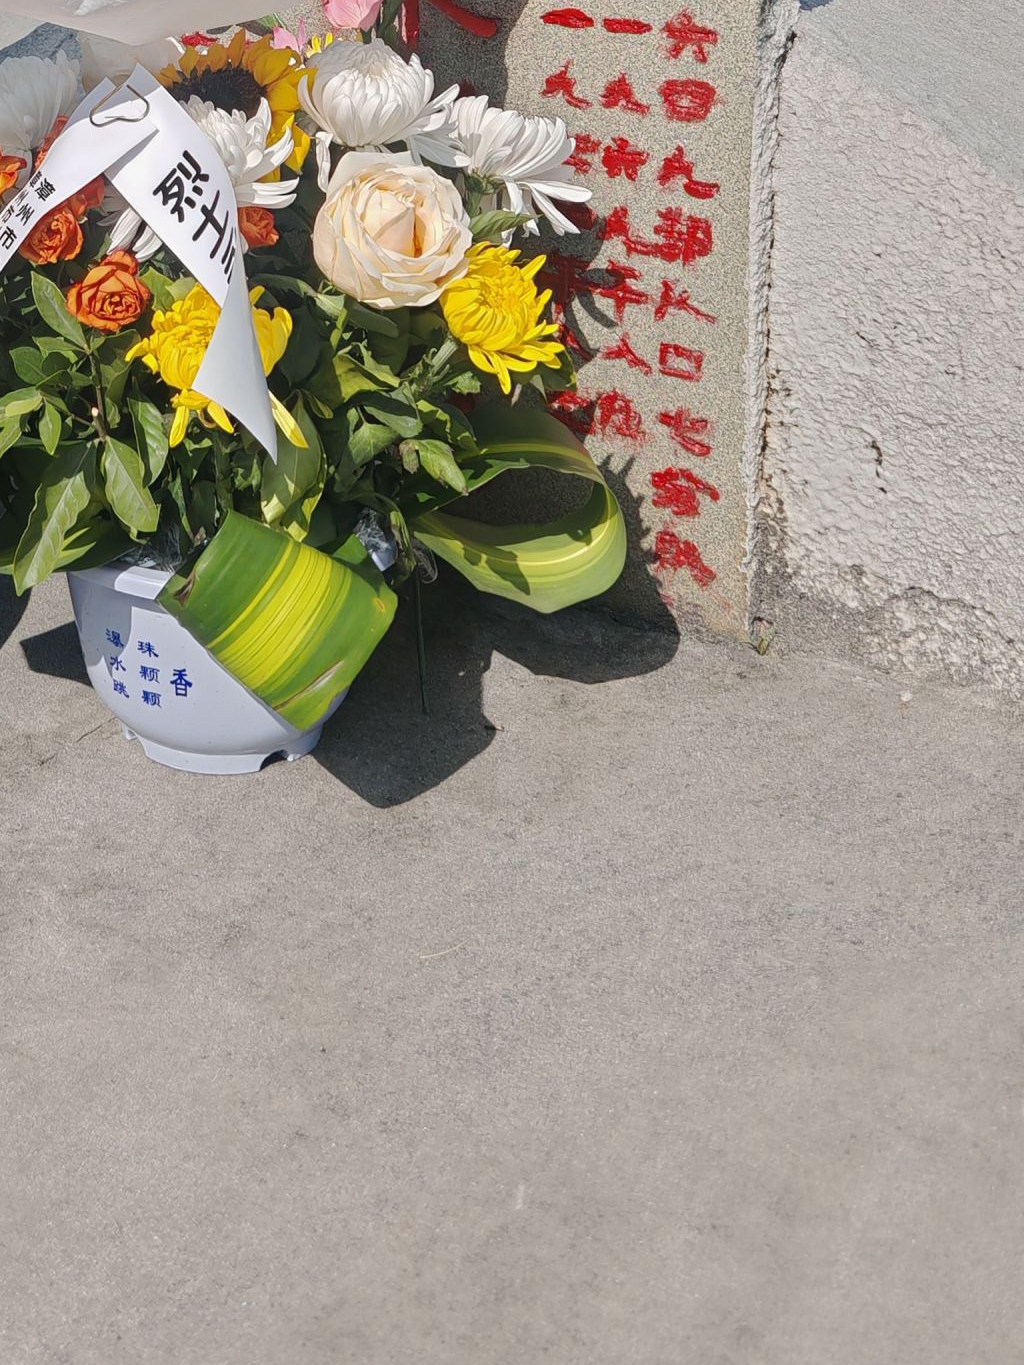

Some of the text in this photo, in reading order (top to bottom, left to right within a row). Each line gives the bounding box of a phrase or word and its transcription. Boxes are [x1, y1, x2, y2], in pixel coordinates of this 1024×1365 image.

[137, 640, 162, 708] 珠颗颗
[169, 668, 193, 698] 香
